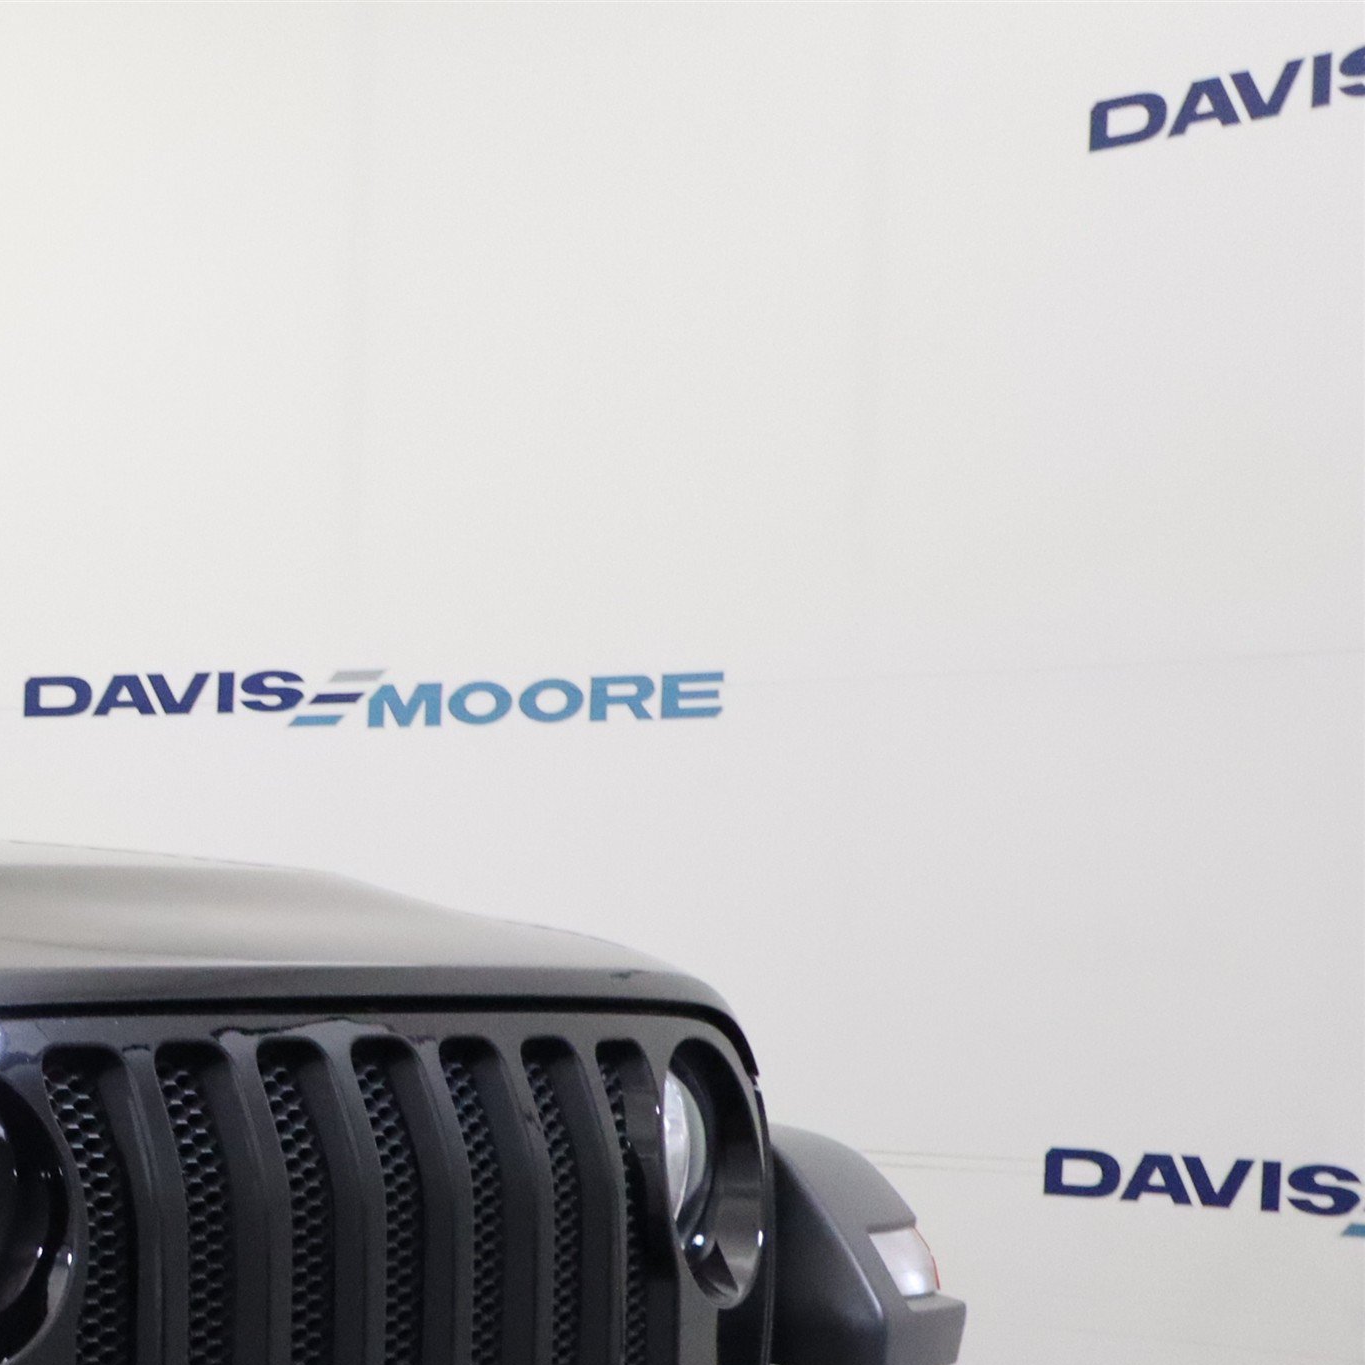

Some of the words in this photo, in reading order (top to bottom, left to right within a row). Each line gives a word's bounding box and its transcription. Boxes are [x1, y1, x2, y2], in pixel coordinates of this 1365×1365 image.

[23, 670, 306, 718] DAVIS
[367, 671, 725, 729] MOORE
[1043, 1147, 1363, 1217] DAVIS
